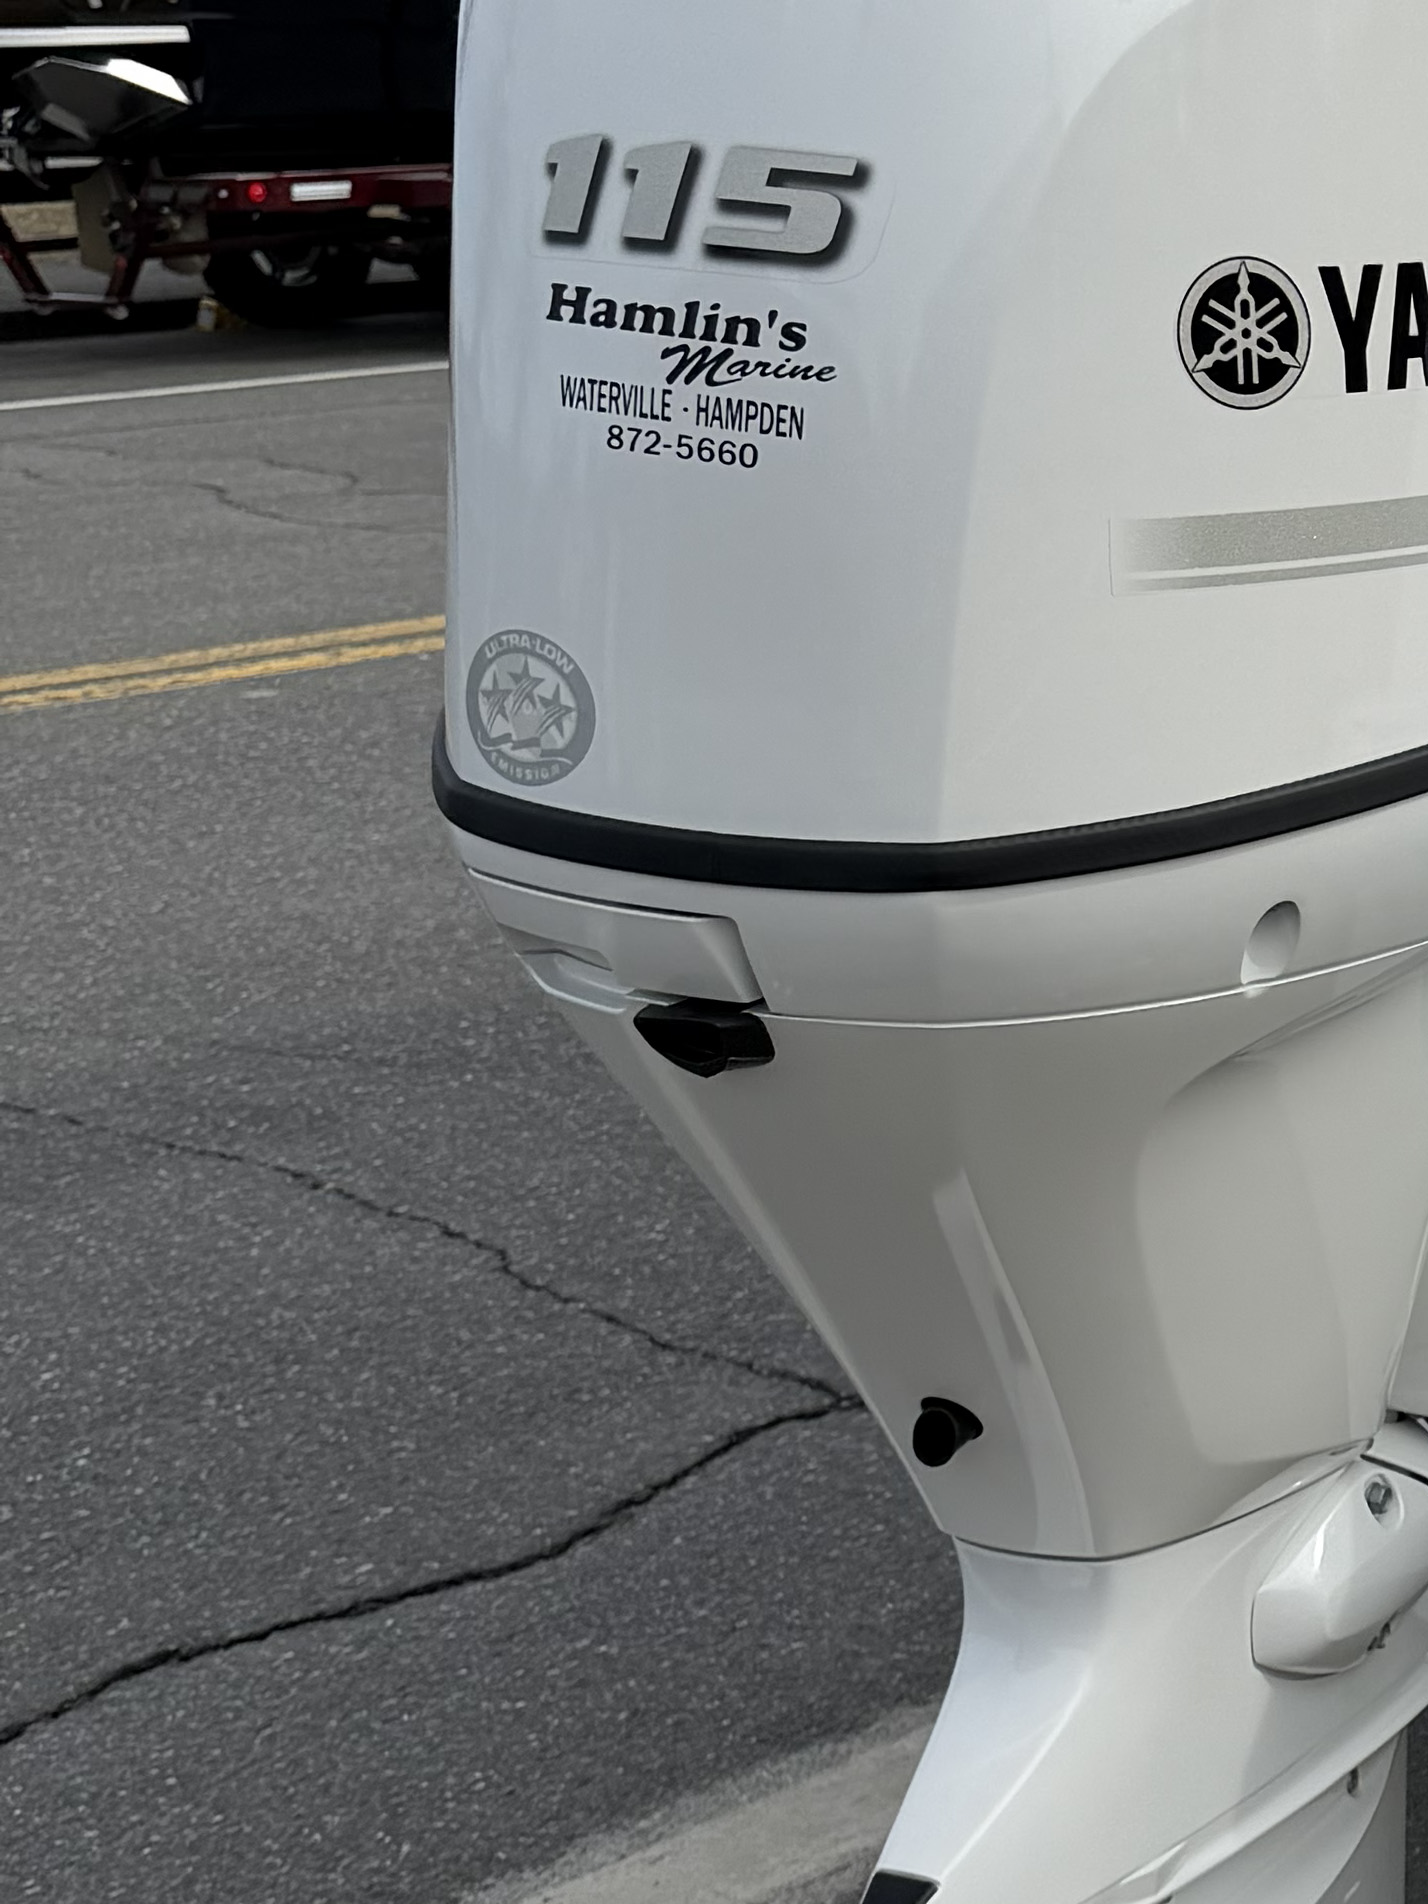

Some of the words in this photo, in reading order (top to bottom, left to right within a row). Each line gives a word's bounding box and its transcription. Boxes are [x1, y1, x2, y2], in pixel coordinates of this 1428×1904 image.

[543, 134, 868, 268] 115
[546, 283, 808, 352] Hamlin's
[661, 344, 838, 387] Marine
[560, 374, 673, 422] WATERVILLE
[696, 394, 805, 440] HAMPDEN
[606, 425, 759, 468] 872-5660
